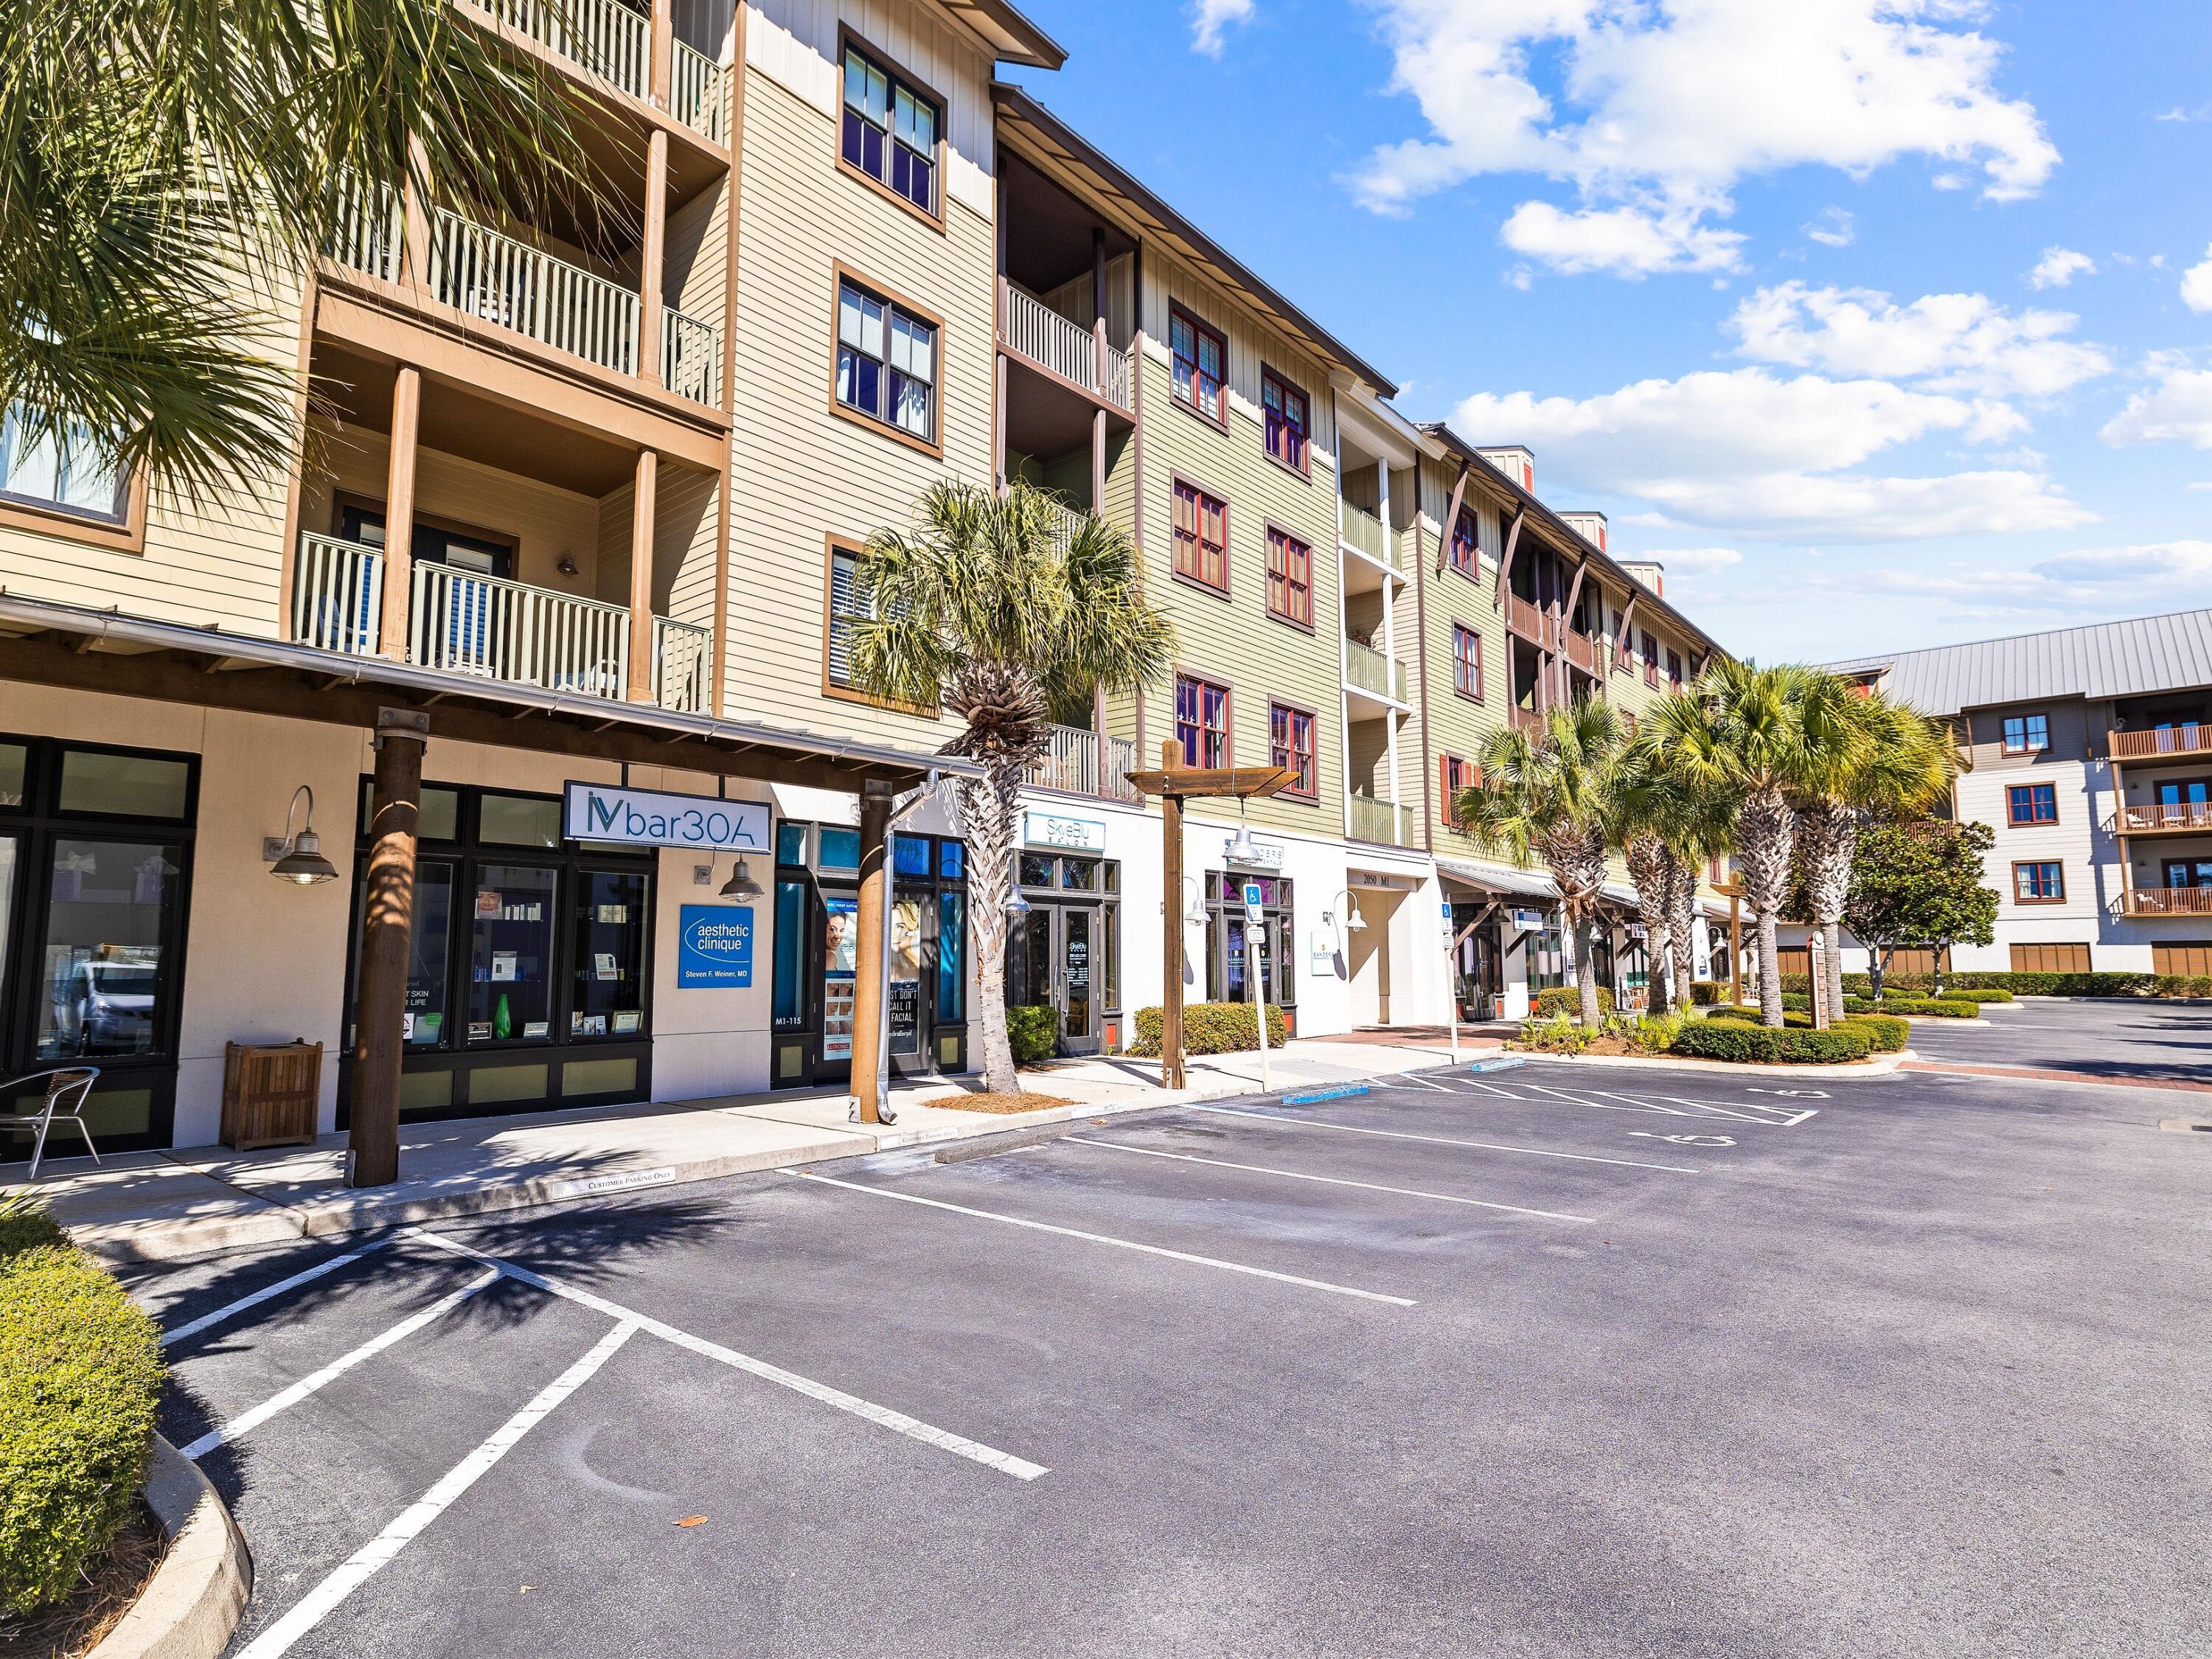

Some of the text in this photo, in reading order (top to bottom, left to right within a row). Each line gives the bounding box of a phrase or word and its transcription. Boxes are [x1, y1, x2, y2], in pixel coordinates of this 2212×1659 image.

[1047, 818, 1089, 839] SkyeBlu
[1048, 837, 1088, 846] SALON
[1259, 849, 1282, 859] DERS
[1363, 874, 1377, 885] 2050
[698, 923, 749, 937] aesthetic
[698, 936, 742, 953] clinique
[900, 990, 918, 1000] DON'T
[905, 1001, 912, 1011] IT
[775, 1017, 801, 1026] M1-115
[891, 1012, 915, 1023] FACIAL.
[588, 1172, 671, 1189] CUSTOMER PARKING ONLY
